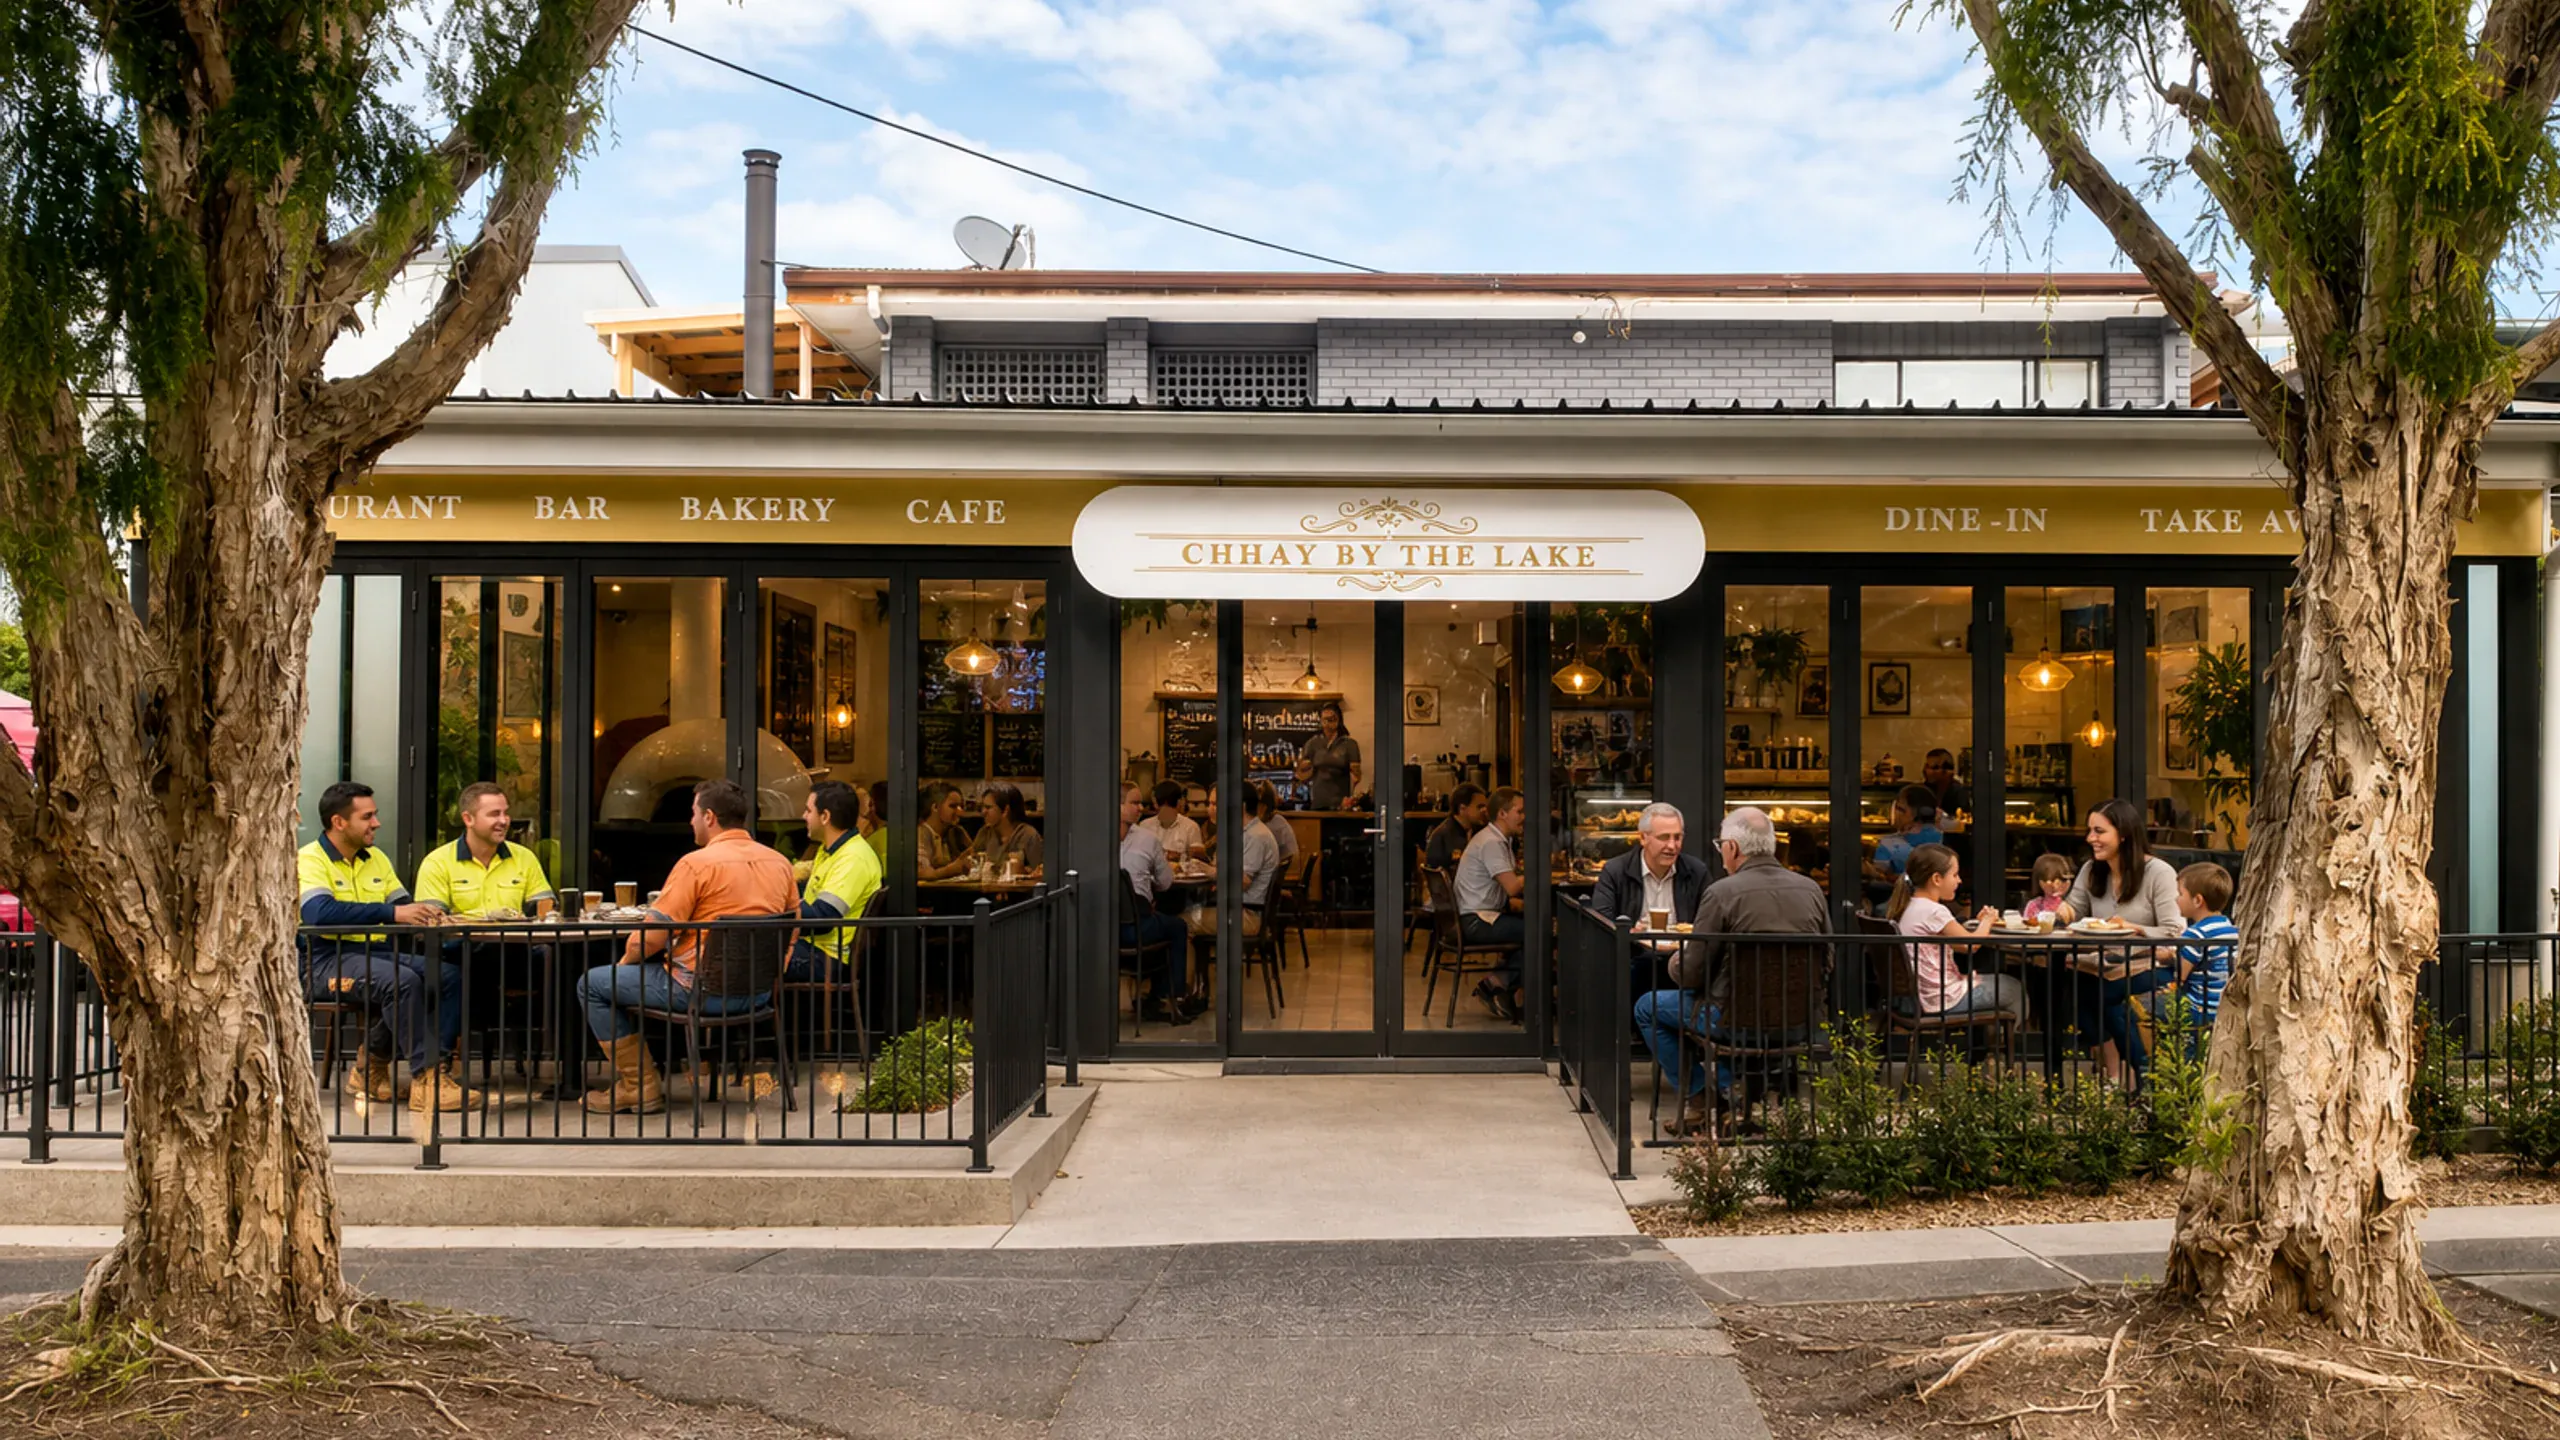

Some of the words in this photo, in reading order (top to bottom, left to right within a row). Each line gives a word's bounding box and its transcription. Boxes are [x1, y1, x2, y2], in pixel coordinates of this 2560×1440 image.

[328, 495, 462, 520] URANT
[534, 497, 610, 520] BAR
[680, 497, 835, 522] BAKERY
[906, 499, 1006, 524] CAFE
[2140, 509, 2243, 533] TAKE
[1181, 542, 1317, 566] CHHAY
[1336, 544, 1382, 567] BY
[1399, 544, 1475, 567] THE
[1493, 545, 1596, 568] LAKE
